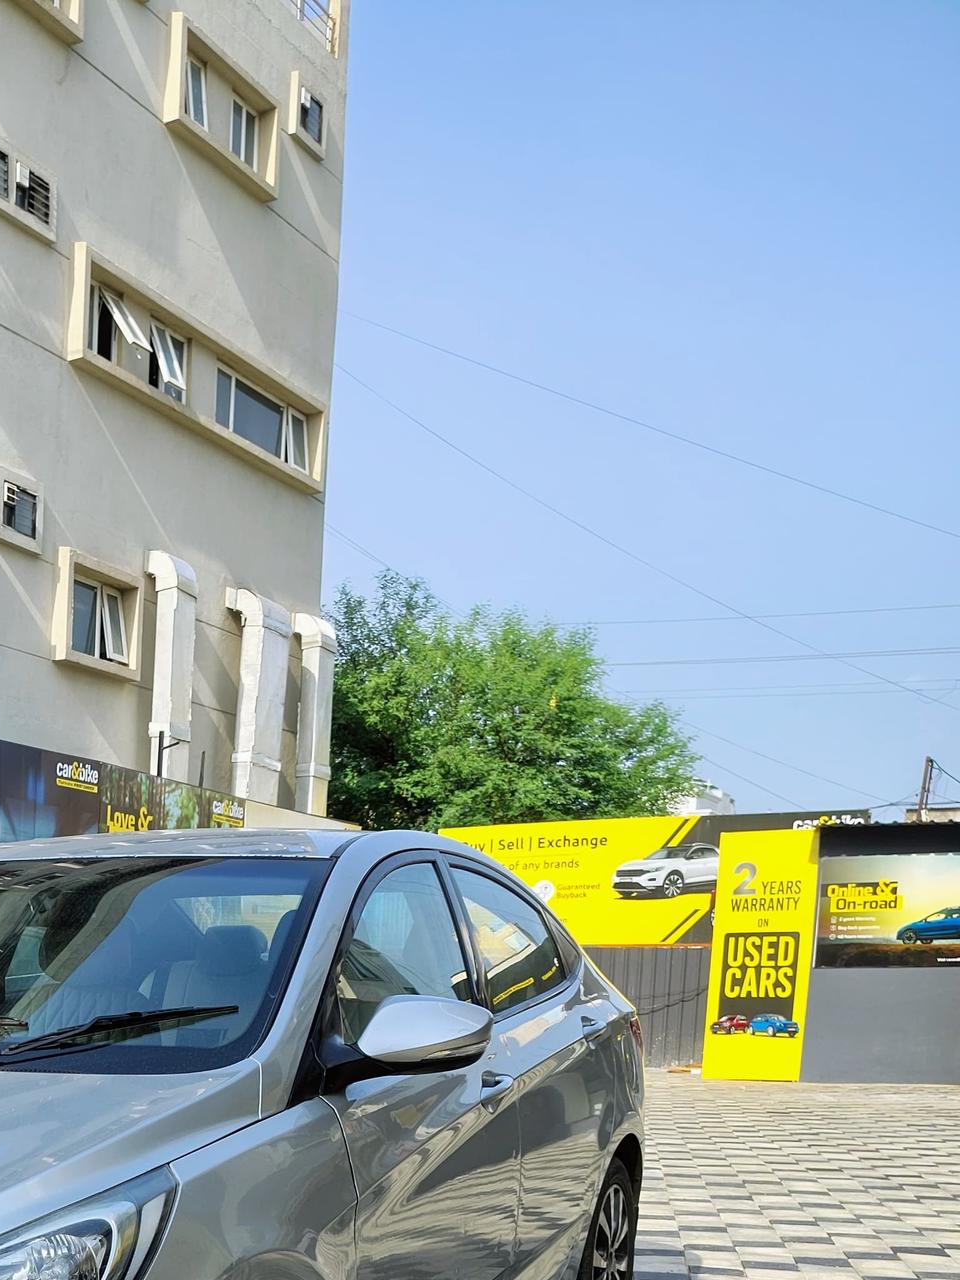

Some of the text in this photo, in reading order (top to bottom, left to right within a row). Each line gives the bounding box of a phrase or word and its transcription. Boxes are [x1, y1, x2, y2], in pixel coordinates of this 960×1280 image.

[56, 761, 99, 784] car&bike
[107, 805, 154, 832] Love &
[213, 800, 244, 819] car&bike
[498, 837, 524, 850] Sell
[538, 835, 608, 850] Exchange
[509, 859, 580, 871] of any brands
[733, 862, 802, 896] 2 YEARS
[827, 880, 899, 898] Online &
[731, 897, 801, 912] WARRANTY
[836, 896, 898, 910] On-road
[757, 918, 769, 928] ON
[727, 935, 796, 967] USED
[724, 967, 794, 998] CARS
